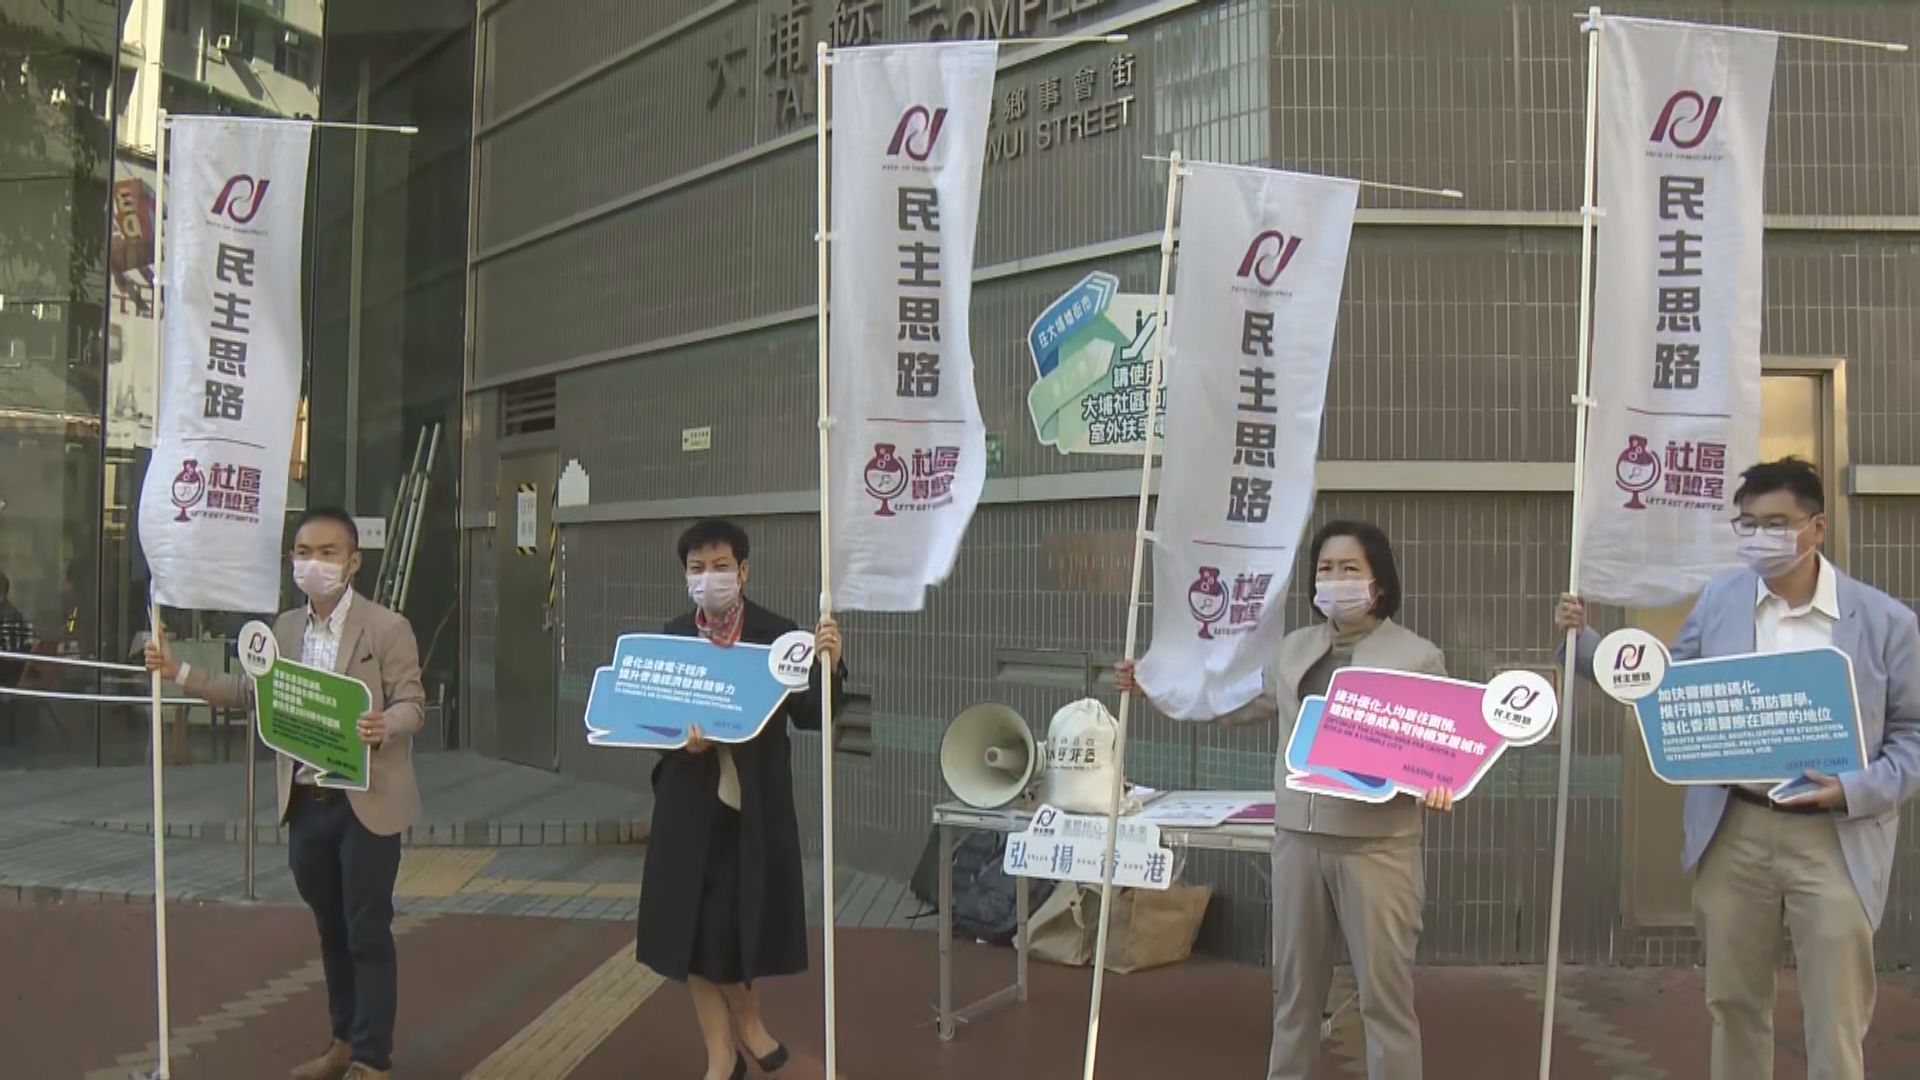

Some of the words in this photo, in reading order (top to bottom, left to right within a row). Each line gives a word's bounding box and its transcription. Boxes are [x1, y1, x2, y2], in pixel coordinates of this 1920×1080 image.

[1036, 94, 1136, 150] STREET
[896, 186, 941, 398] 民主思路
[1653, 175, 1705, 390] 民主思路
[203, 243, 255, 421] 民主思路
[1113, 359, 1164, 389] 請使用
[1226, 310, 1277, 523] 民主思路
[912, 446, 960, 477] 社區
[1665, 440, 1726, 475] 社區
[207, 462, 262, 494] 社區
[617, 668, 736, 695] 提升香港經濟發展競爭力
[622, 656, 708, 678] 優化法律電子程序
[1662, 706, 1832, 735] 強化香港醫療在國際的地位
